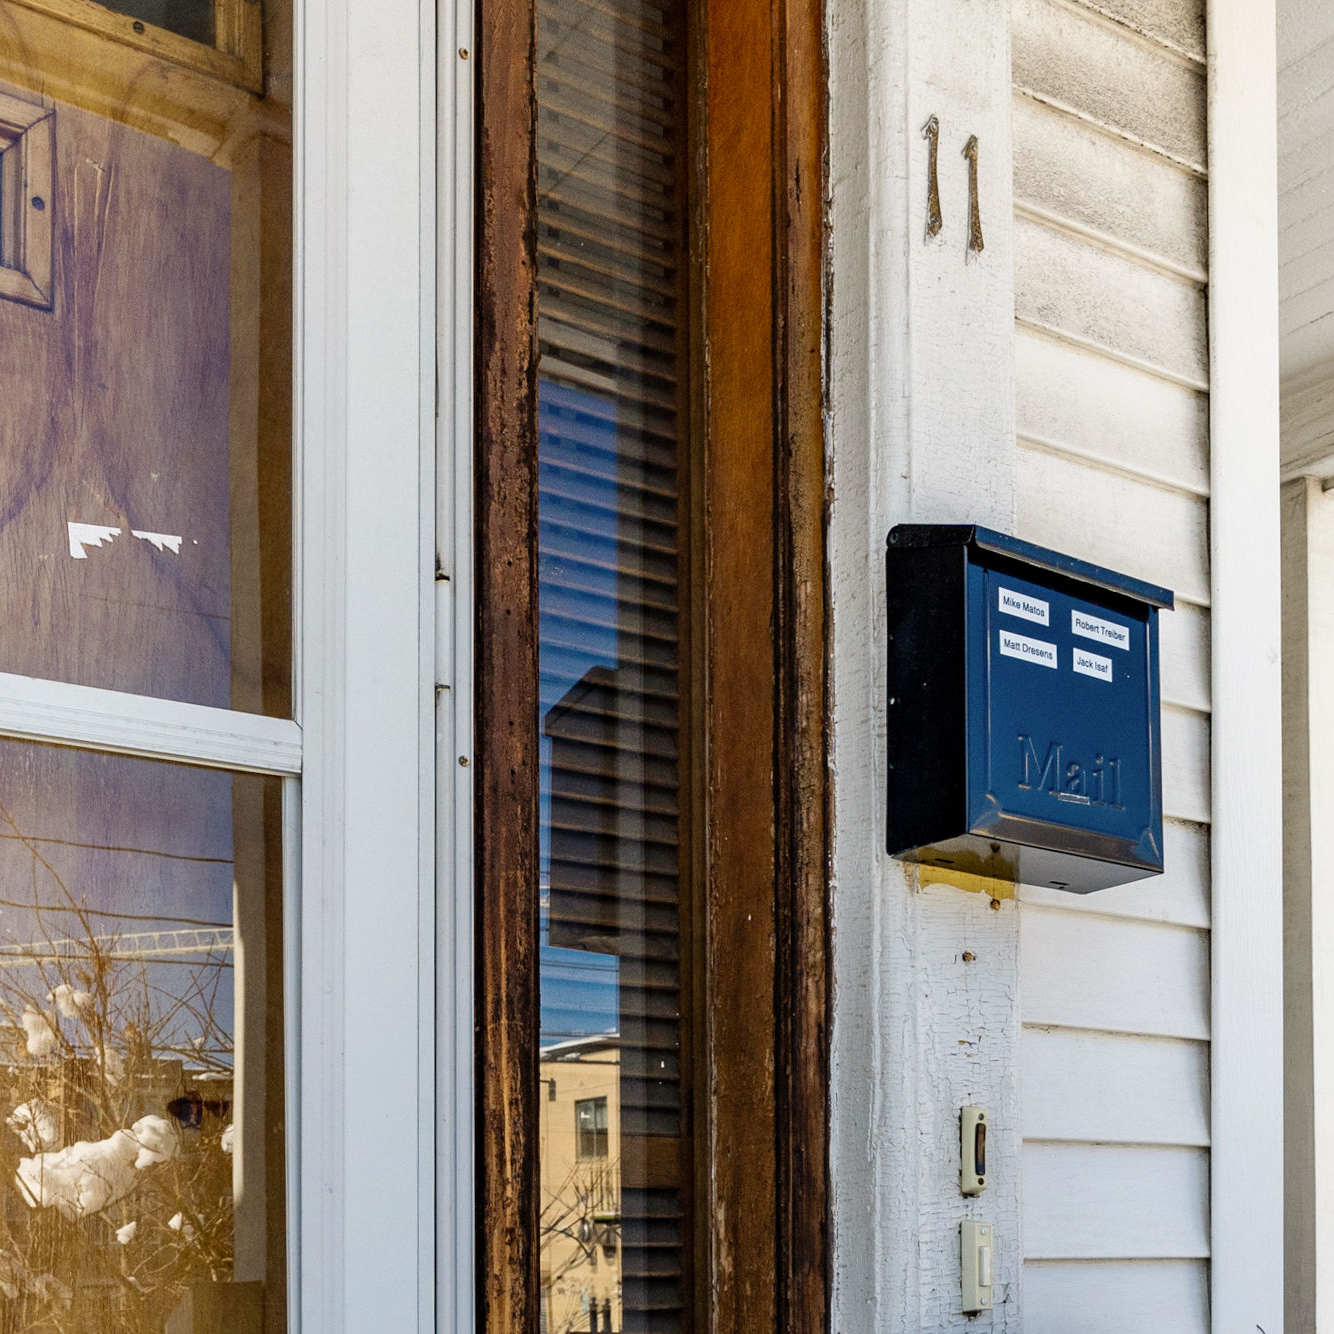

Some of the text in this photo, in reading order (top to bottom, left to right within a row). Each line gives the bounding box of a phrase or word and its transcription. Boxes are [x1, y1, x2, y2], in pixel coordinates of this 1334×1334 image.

[921, 114, 984, 252] 11
[1003, 595, 1045, 617] Mike Matos
[1075, 618, 1126, 641] Robert Treiber
[1003, 638, 1020, 651] Matt
[1077, 656, 1093, 669] Jack
[1017, 733, 1126, 811] Mail
